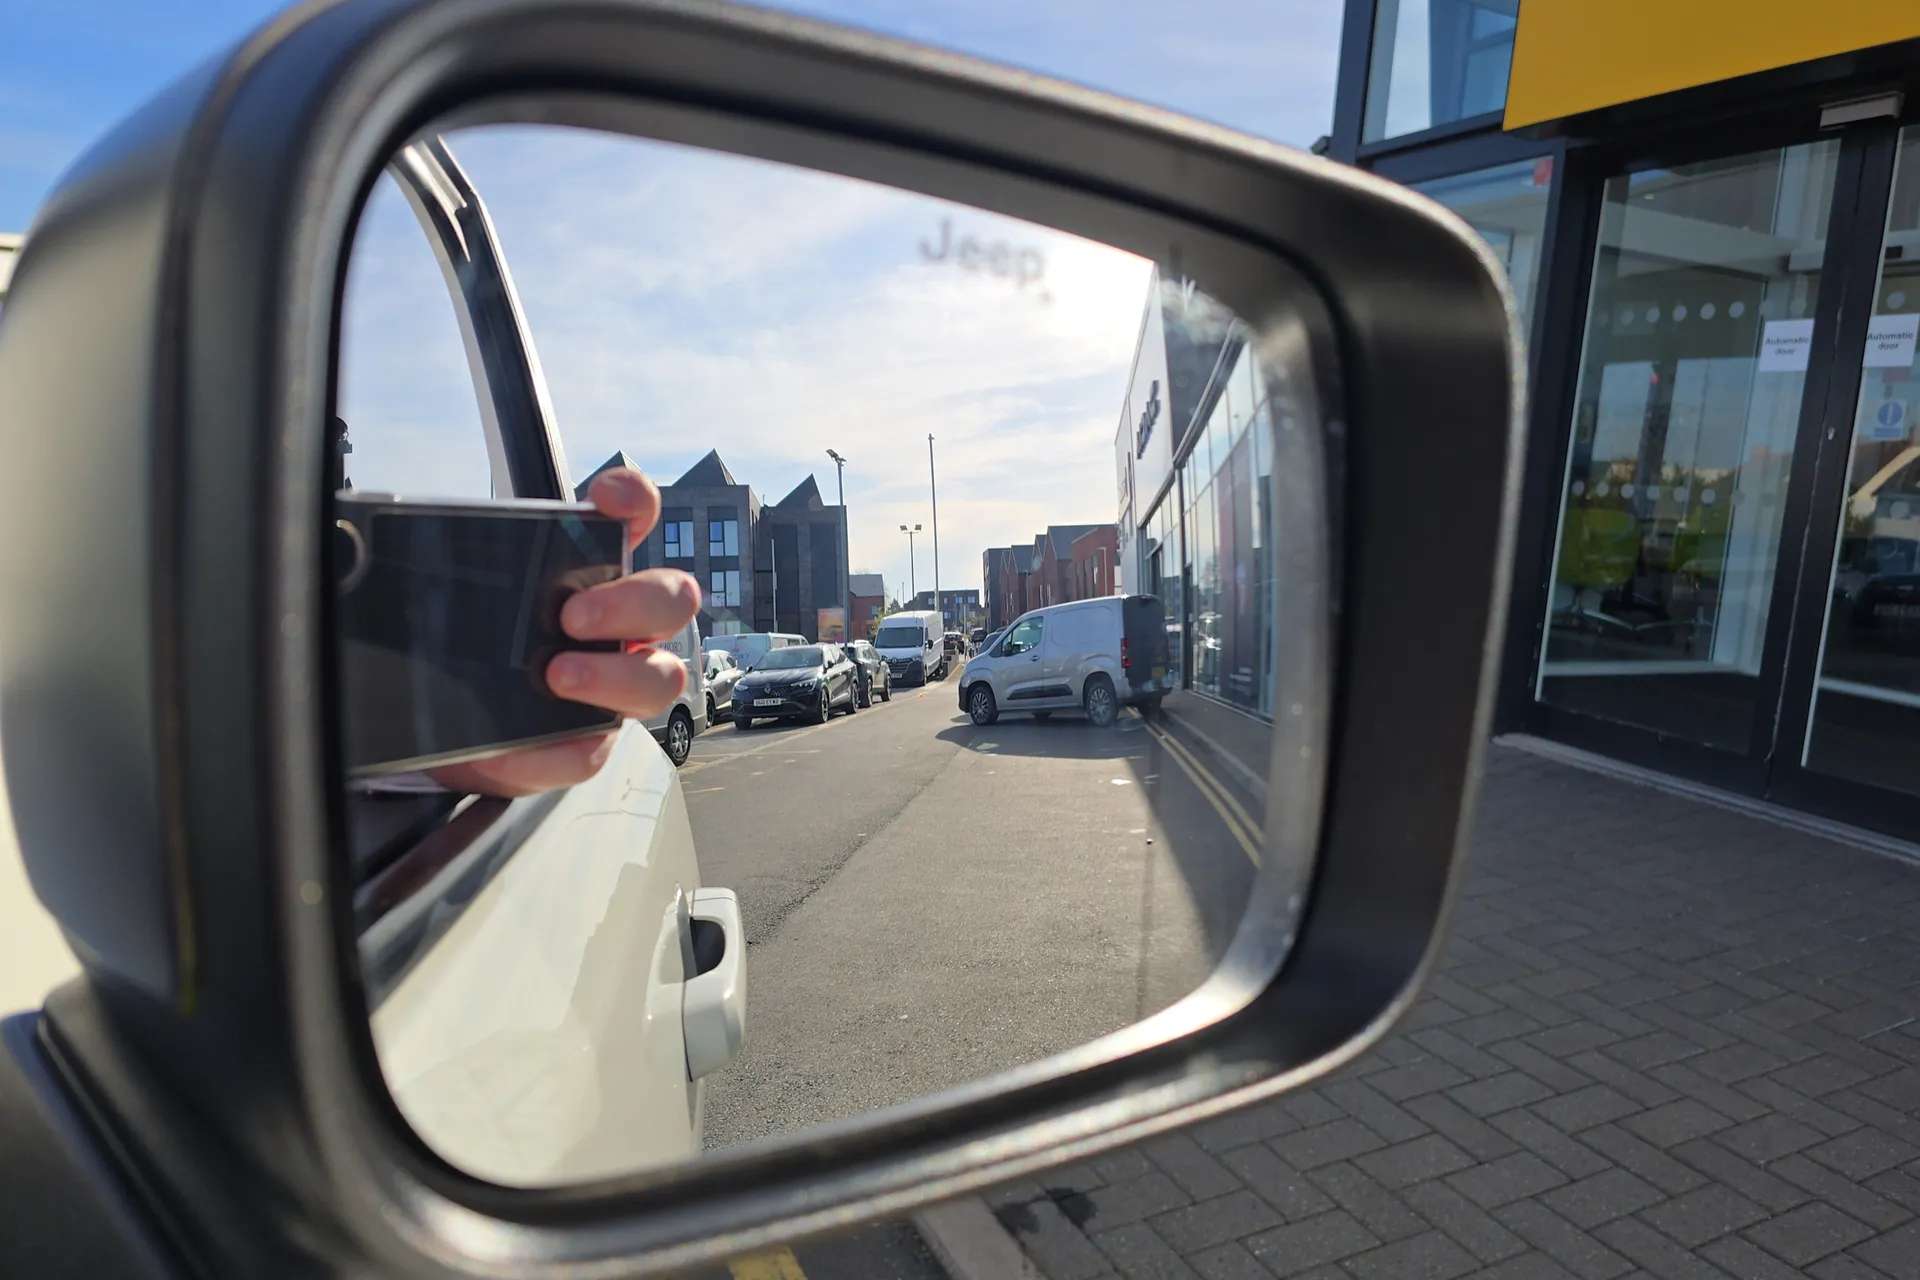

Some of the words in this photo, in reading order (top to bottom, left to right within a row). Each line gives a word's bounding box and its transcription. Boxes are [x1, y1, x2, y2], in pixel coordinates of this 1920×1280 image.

[918, 218, 1044, 288] Jeep
[1765, 335, 1809, 345] Automatic
[1867, 331, 1914, 341] Automatic
